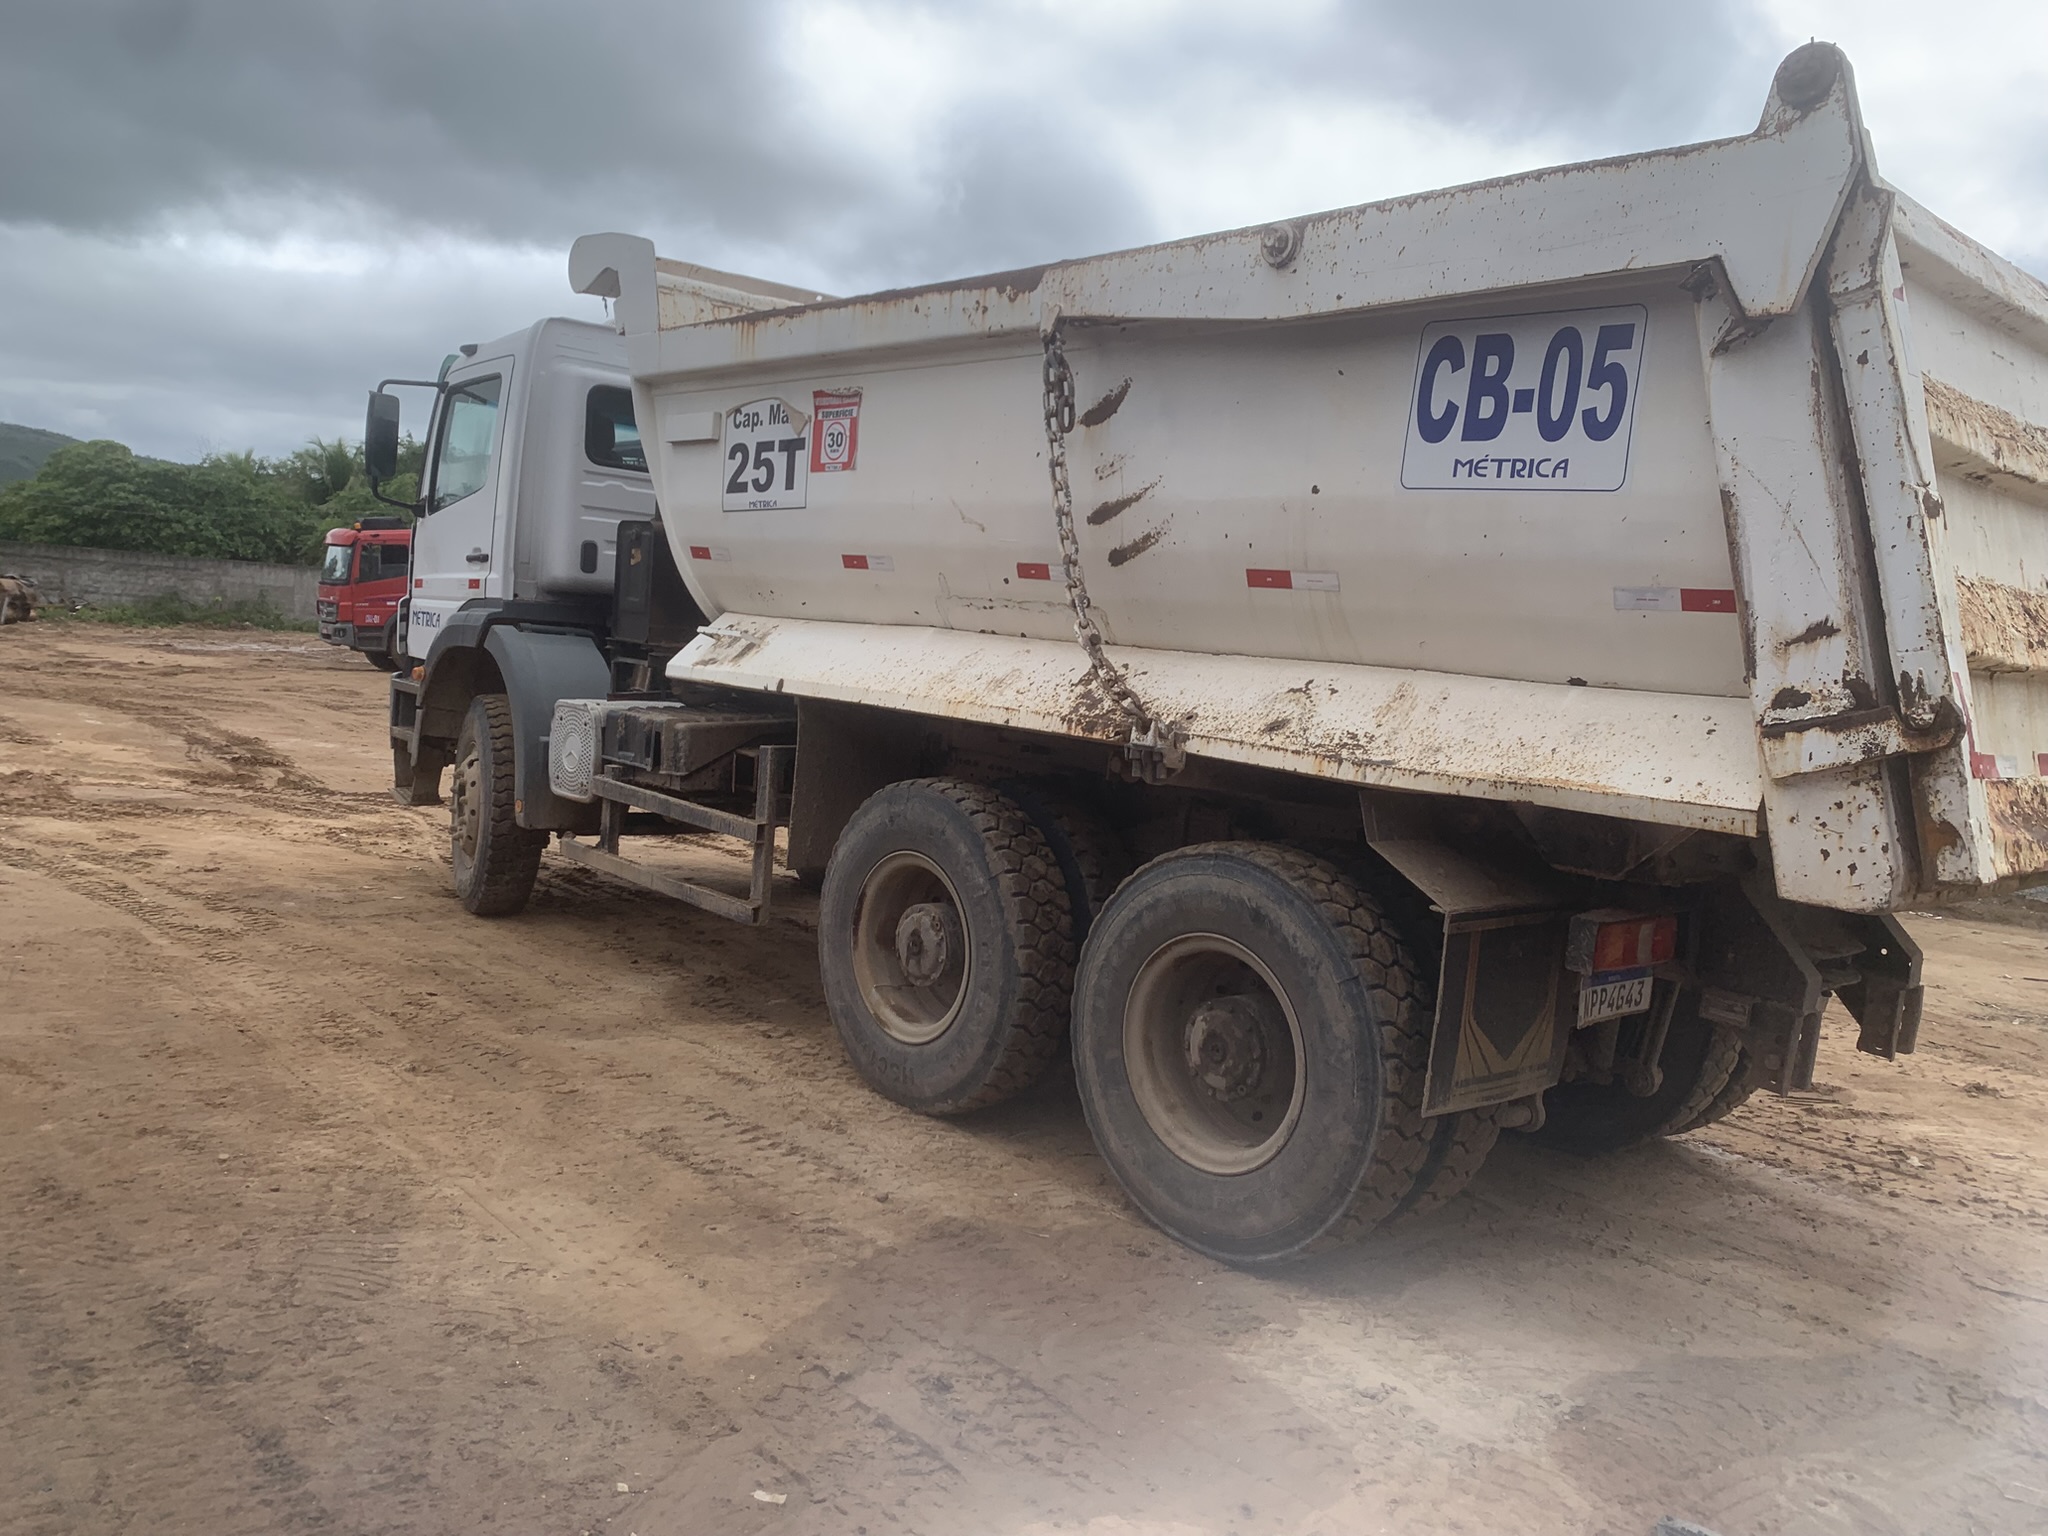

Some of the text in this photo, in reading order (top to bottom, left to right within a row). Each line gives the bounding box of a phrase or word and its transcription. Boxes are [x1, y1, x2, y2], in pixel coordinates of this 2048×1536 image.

[1417, 322, 1636, 444] CB-05
[733, 403, 792, 433] Cap. Ma
[827, 431, 844, 449] 30
[726, 437, 806, 494] 25T
[1452, 454, 1570, 479] MÉTRICA
